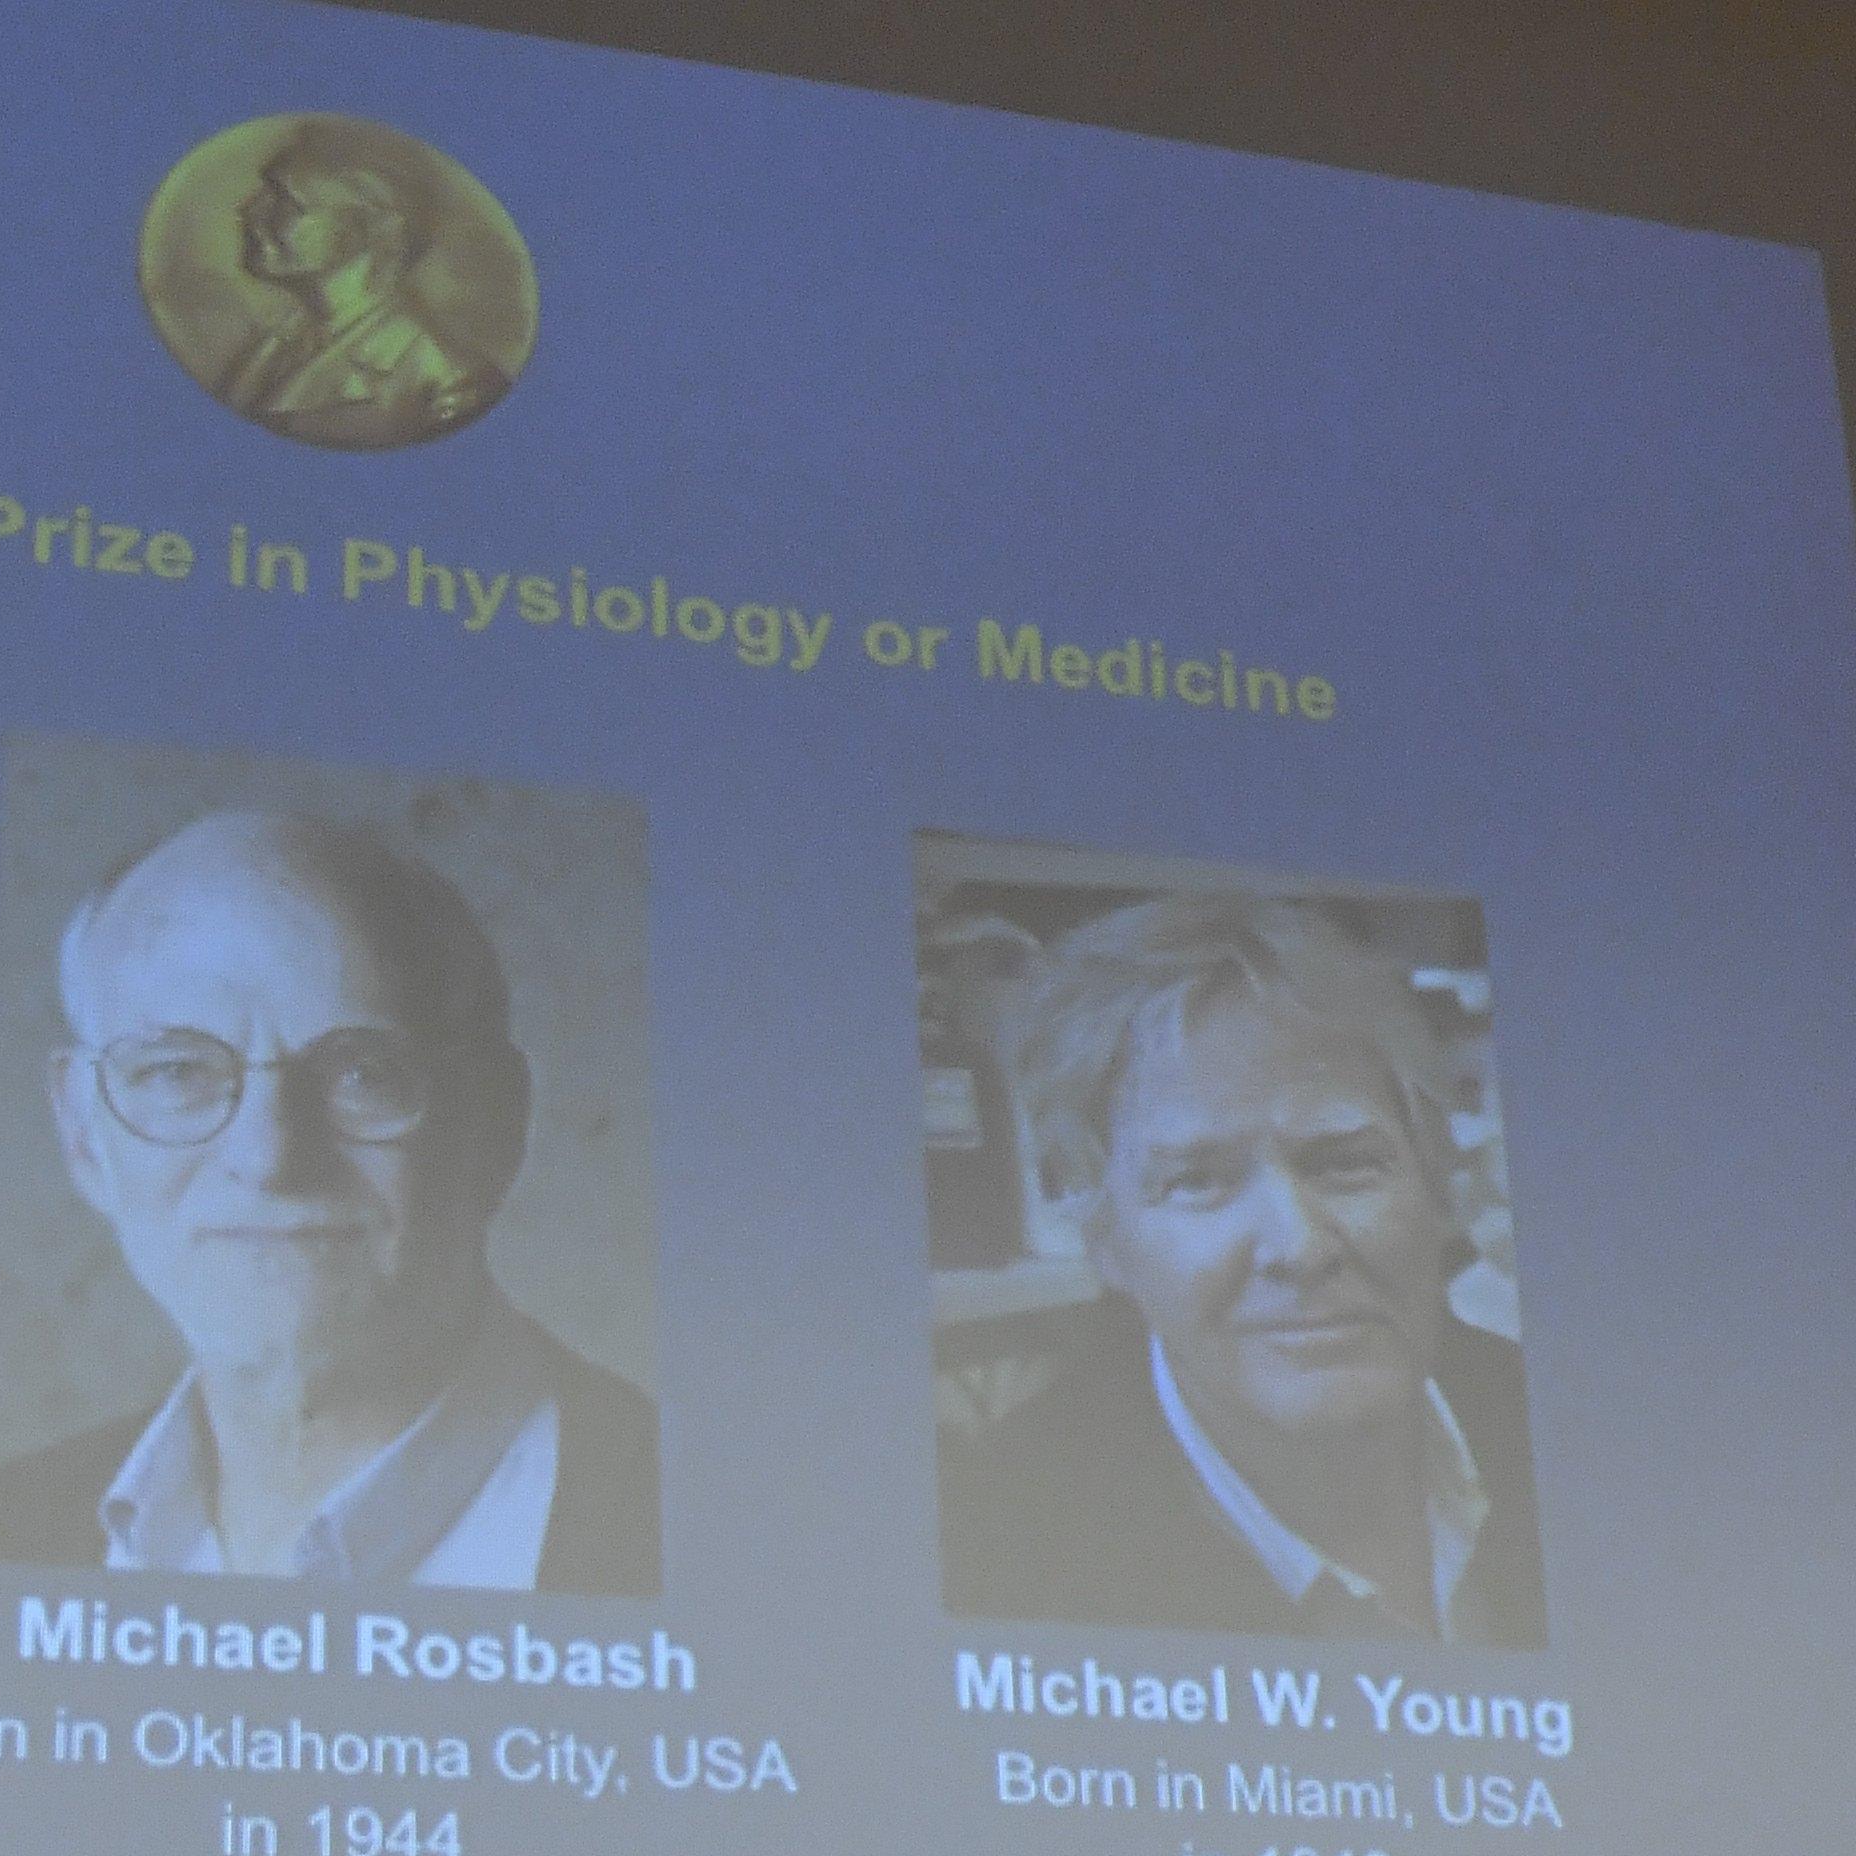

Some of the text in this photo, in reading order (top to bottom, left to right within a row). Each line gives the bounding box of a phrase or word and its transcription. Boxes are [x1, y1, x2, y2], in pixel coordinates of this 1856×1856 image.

[227, 523, 309, 595] in
[344, 537, 833, 673] Physiology
[863, 618, 948, 672] or
[976, 618, 1338, 721] Medicine
[19, 1597, 696, 1692] Michael Rosbash
[956, 1650, 1574, 1757] Michael W. Young
[53, 1708, 108, 1764] in
[133, 1709, 470, 1780] Oklahoma
[494, 1728, 627, 1799] City,
[653, 1735, 798, 1794] USA
[997, 1751, 1563, 1829] Born in Miami, USA
